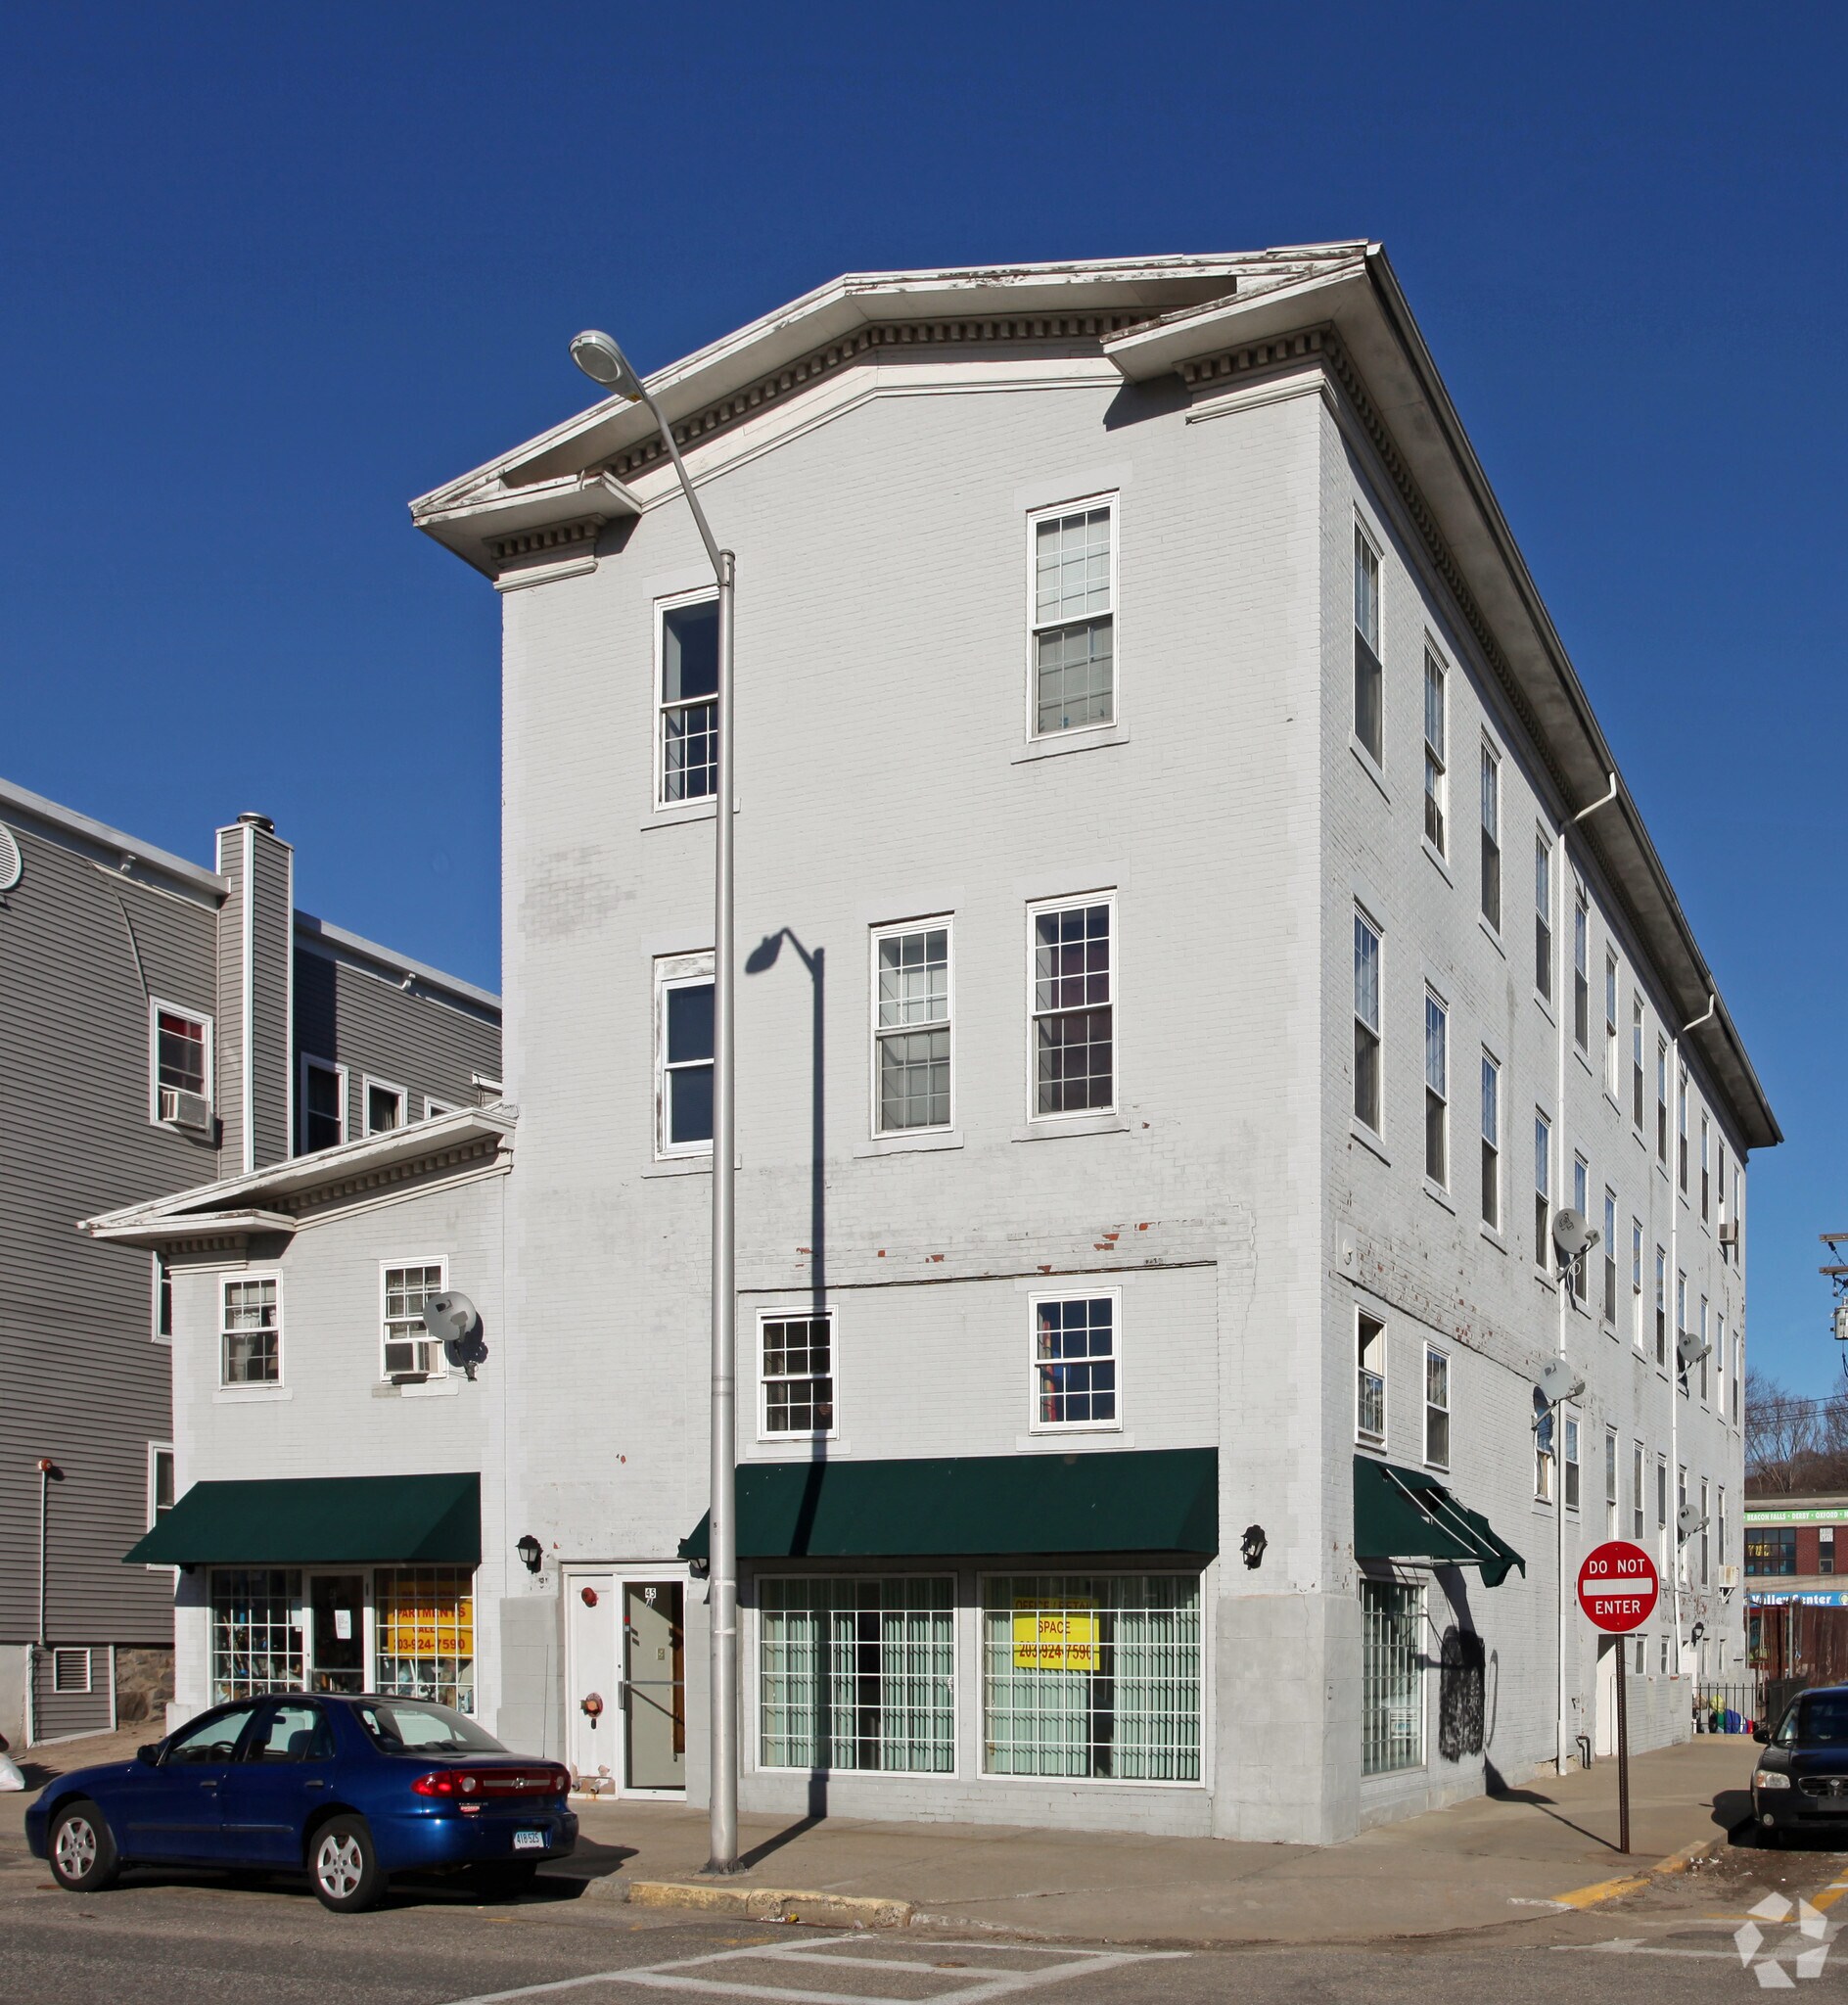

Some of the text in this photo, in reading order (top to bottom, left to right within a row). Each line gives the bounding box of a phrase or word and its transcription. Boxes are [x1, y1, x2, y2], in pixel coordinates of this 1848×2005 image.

[1590, 1559, 1645, 1574] DO NOT
[646, 1588, 656, 1598] 45
[392, 1607, 466, 1618] PARTMNTS
[1595, 1600, 1640, 1614] ENTER
[1039, 1620, 1071, 1634] SPACE
